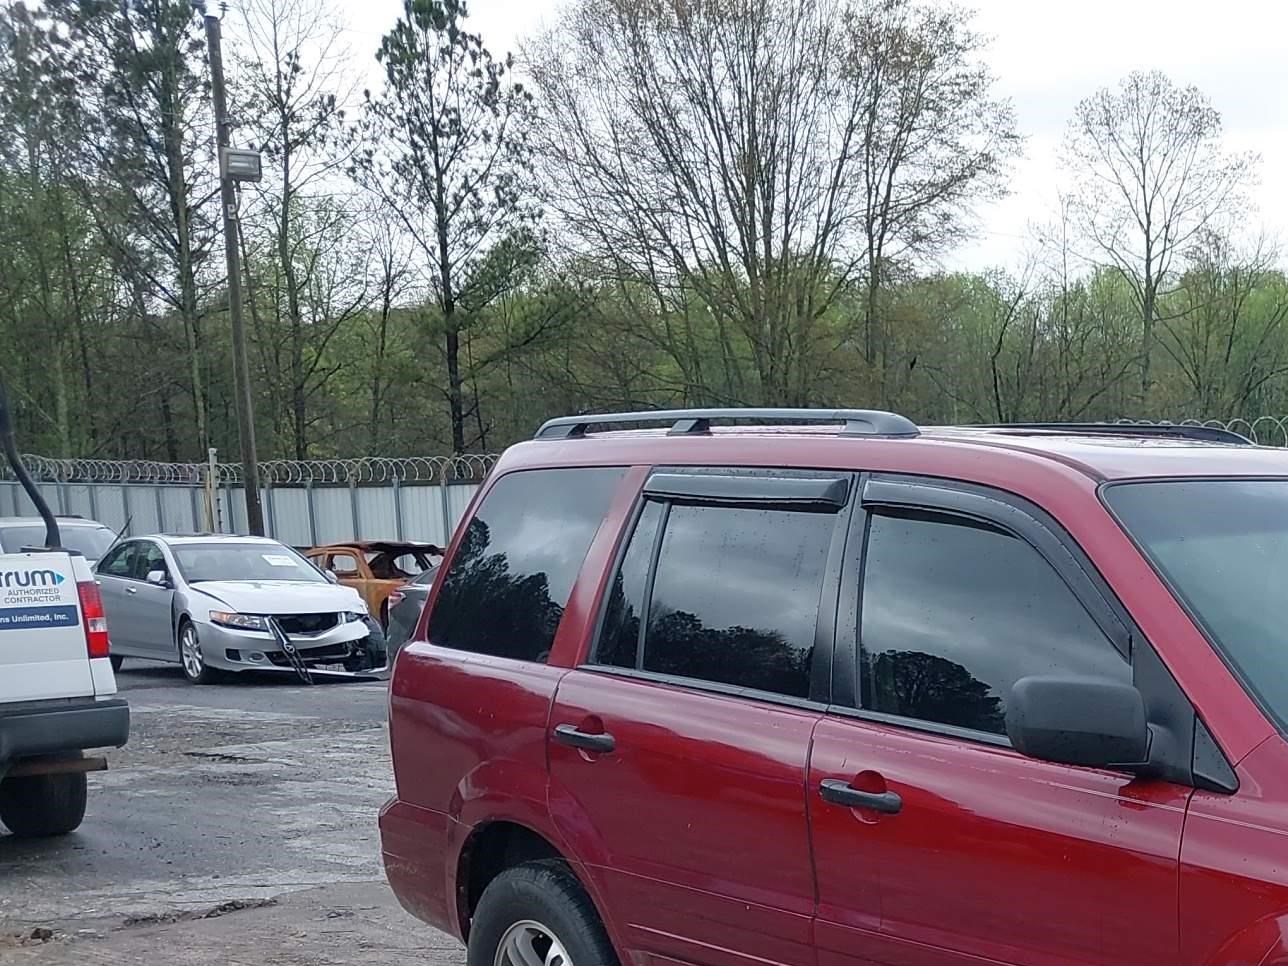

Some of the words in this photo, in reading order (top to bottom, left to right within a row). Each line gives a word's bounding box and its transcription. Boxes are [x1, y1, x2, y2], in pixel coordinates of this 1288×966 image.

[8, 588, 59, 596] AUTHORIZED
[4, 595, 61, 604] CONTRACTOR
[11, 613, 53, 623] Unlimited,
